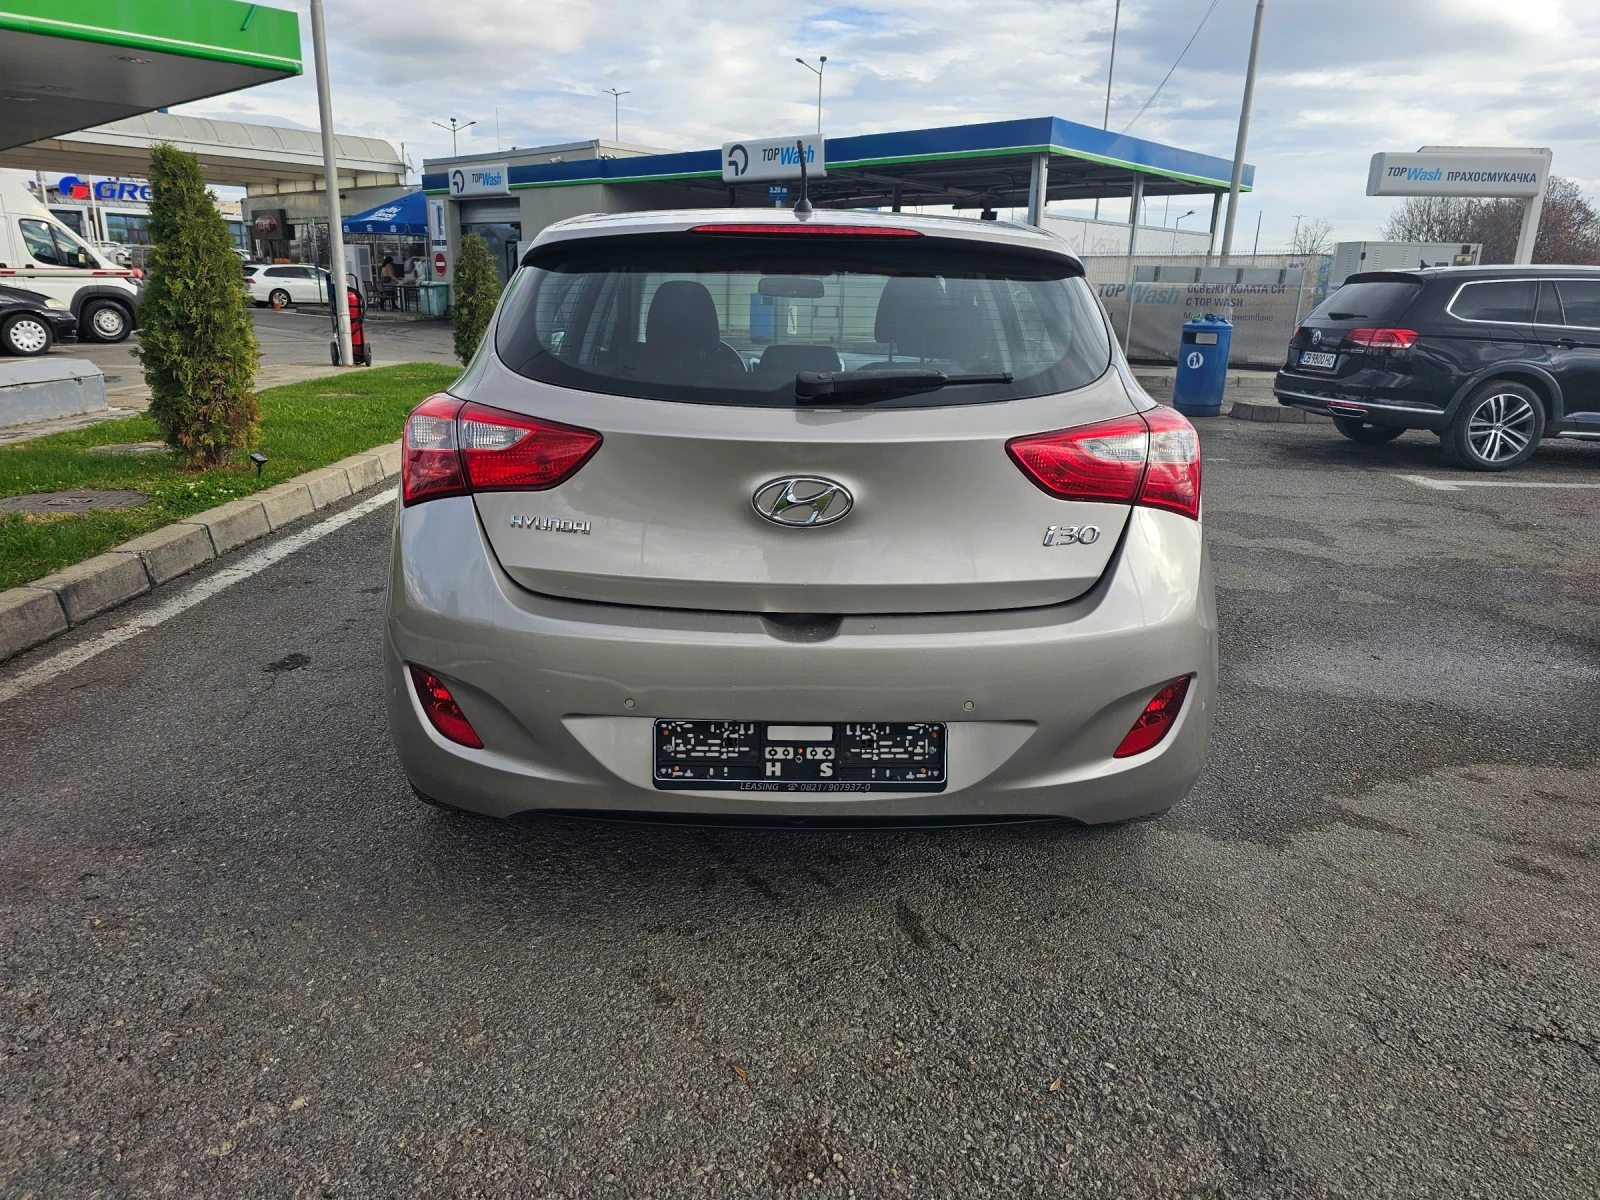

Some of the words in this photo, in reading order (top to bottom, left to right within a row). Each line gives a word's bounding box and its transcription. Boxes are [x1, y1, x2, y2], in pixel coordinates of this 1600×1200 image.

[1446, 172, 1537, 183] ПРАХОСМУКАЧКА
[1187, 284, 1229, 294] ОСВЕЖИ
[1230, 284, 1268, 294] КОЛАТА
[1194, 298, 1212, 307] TOP
[1214, 298, 1243, 307] WASH
[510, 514, 592, 535] HYUNDAI
[1043, 525, 1101, 547] i30
[740, 782, 779, 791] LEASING
[800, 783, 871, 792] 0821/907937-0
